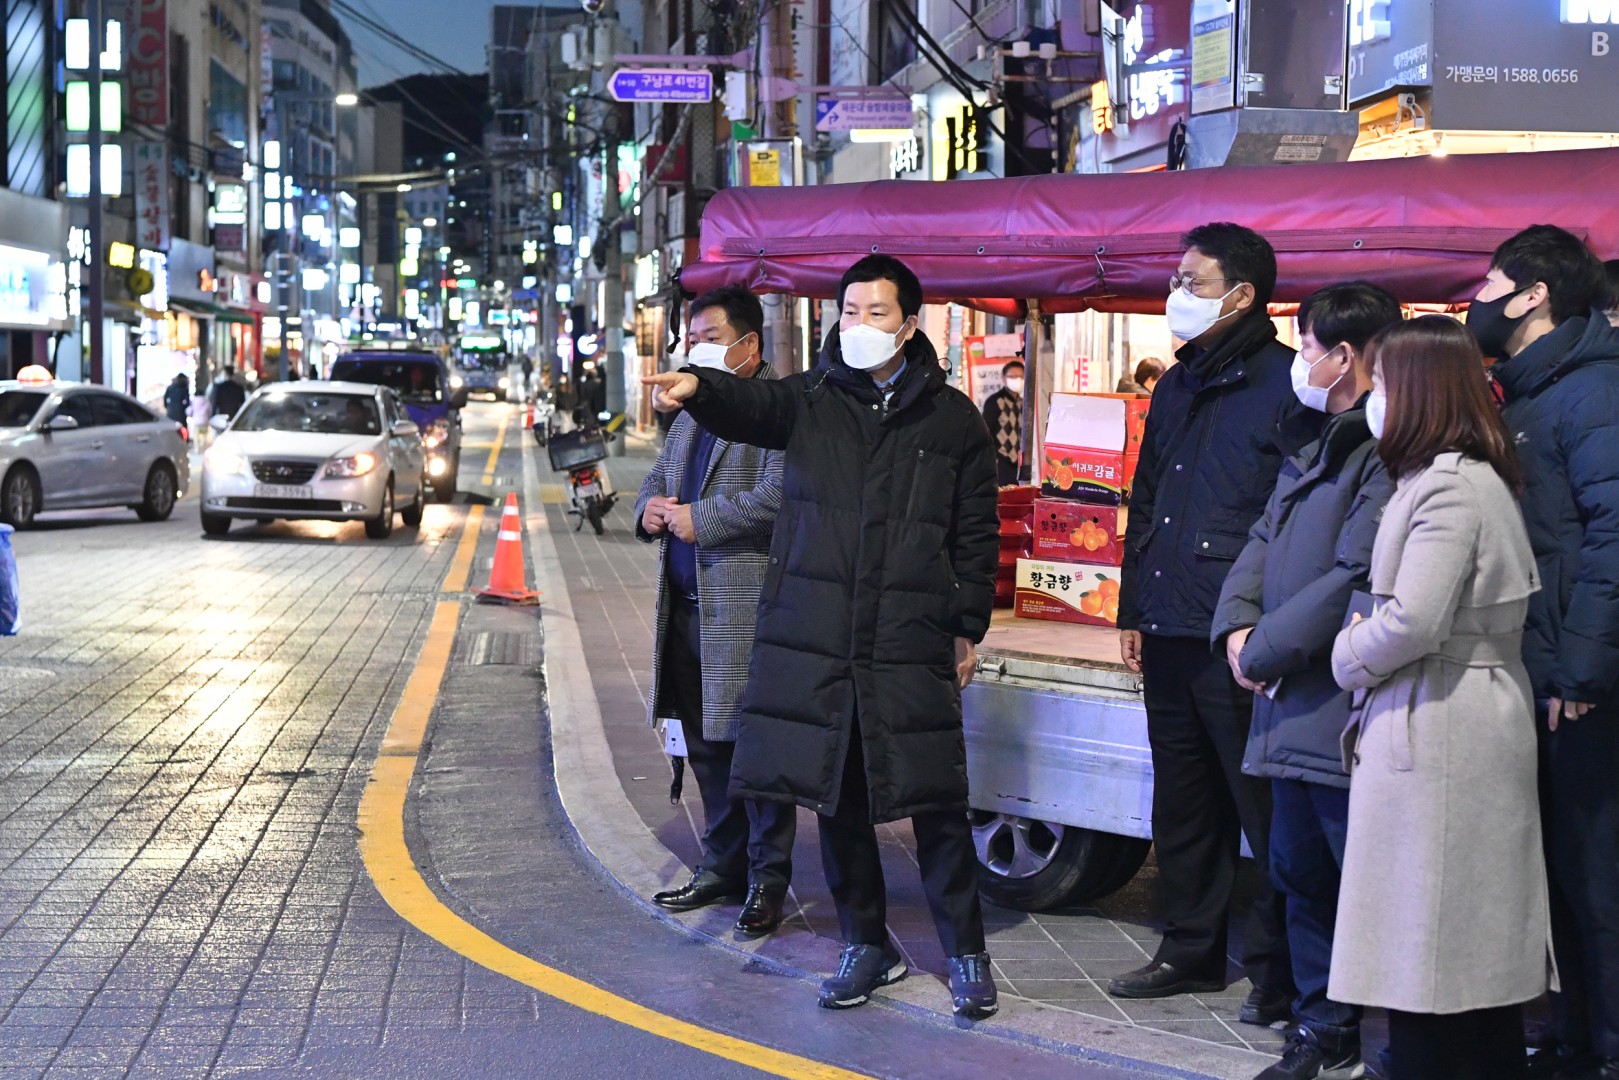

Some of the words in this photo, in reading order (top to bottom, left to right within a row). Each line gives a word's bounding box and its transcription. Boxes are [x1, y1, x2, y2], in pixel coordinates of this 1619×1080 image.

[1446, 66, 1498, 83] 가맹문의
[1503, 68, 1578, 84] 1588.0656
[1072, 462, 1093, 474] 서귀포
[1094, 464, 1115, 479] 감귤
[1030, 571, 1072, 592] 황금향
